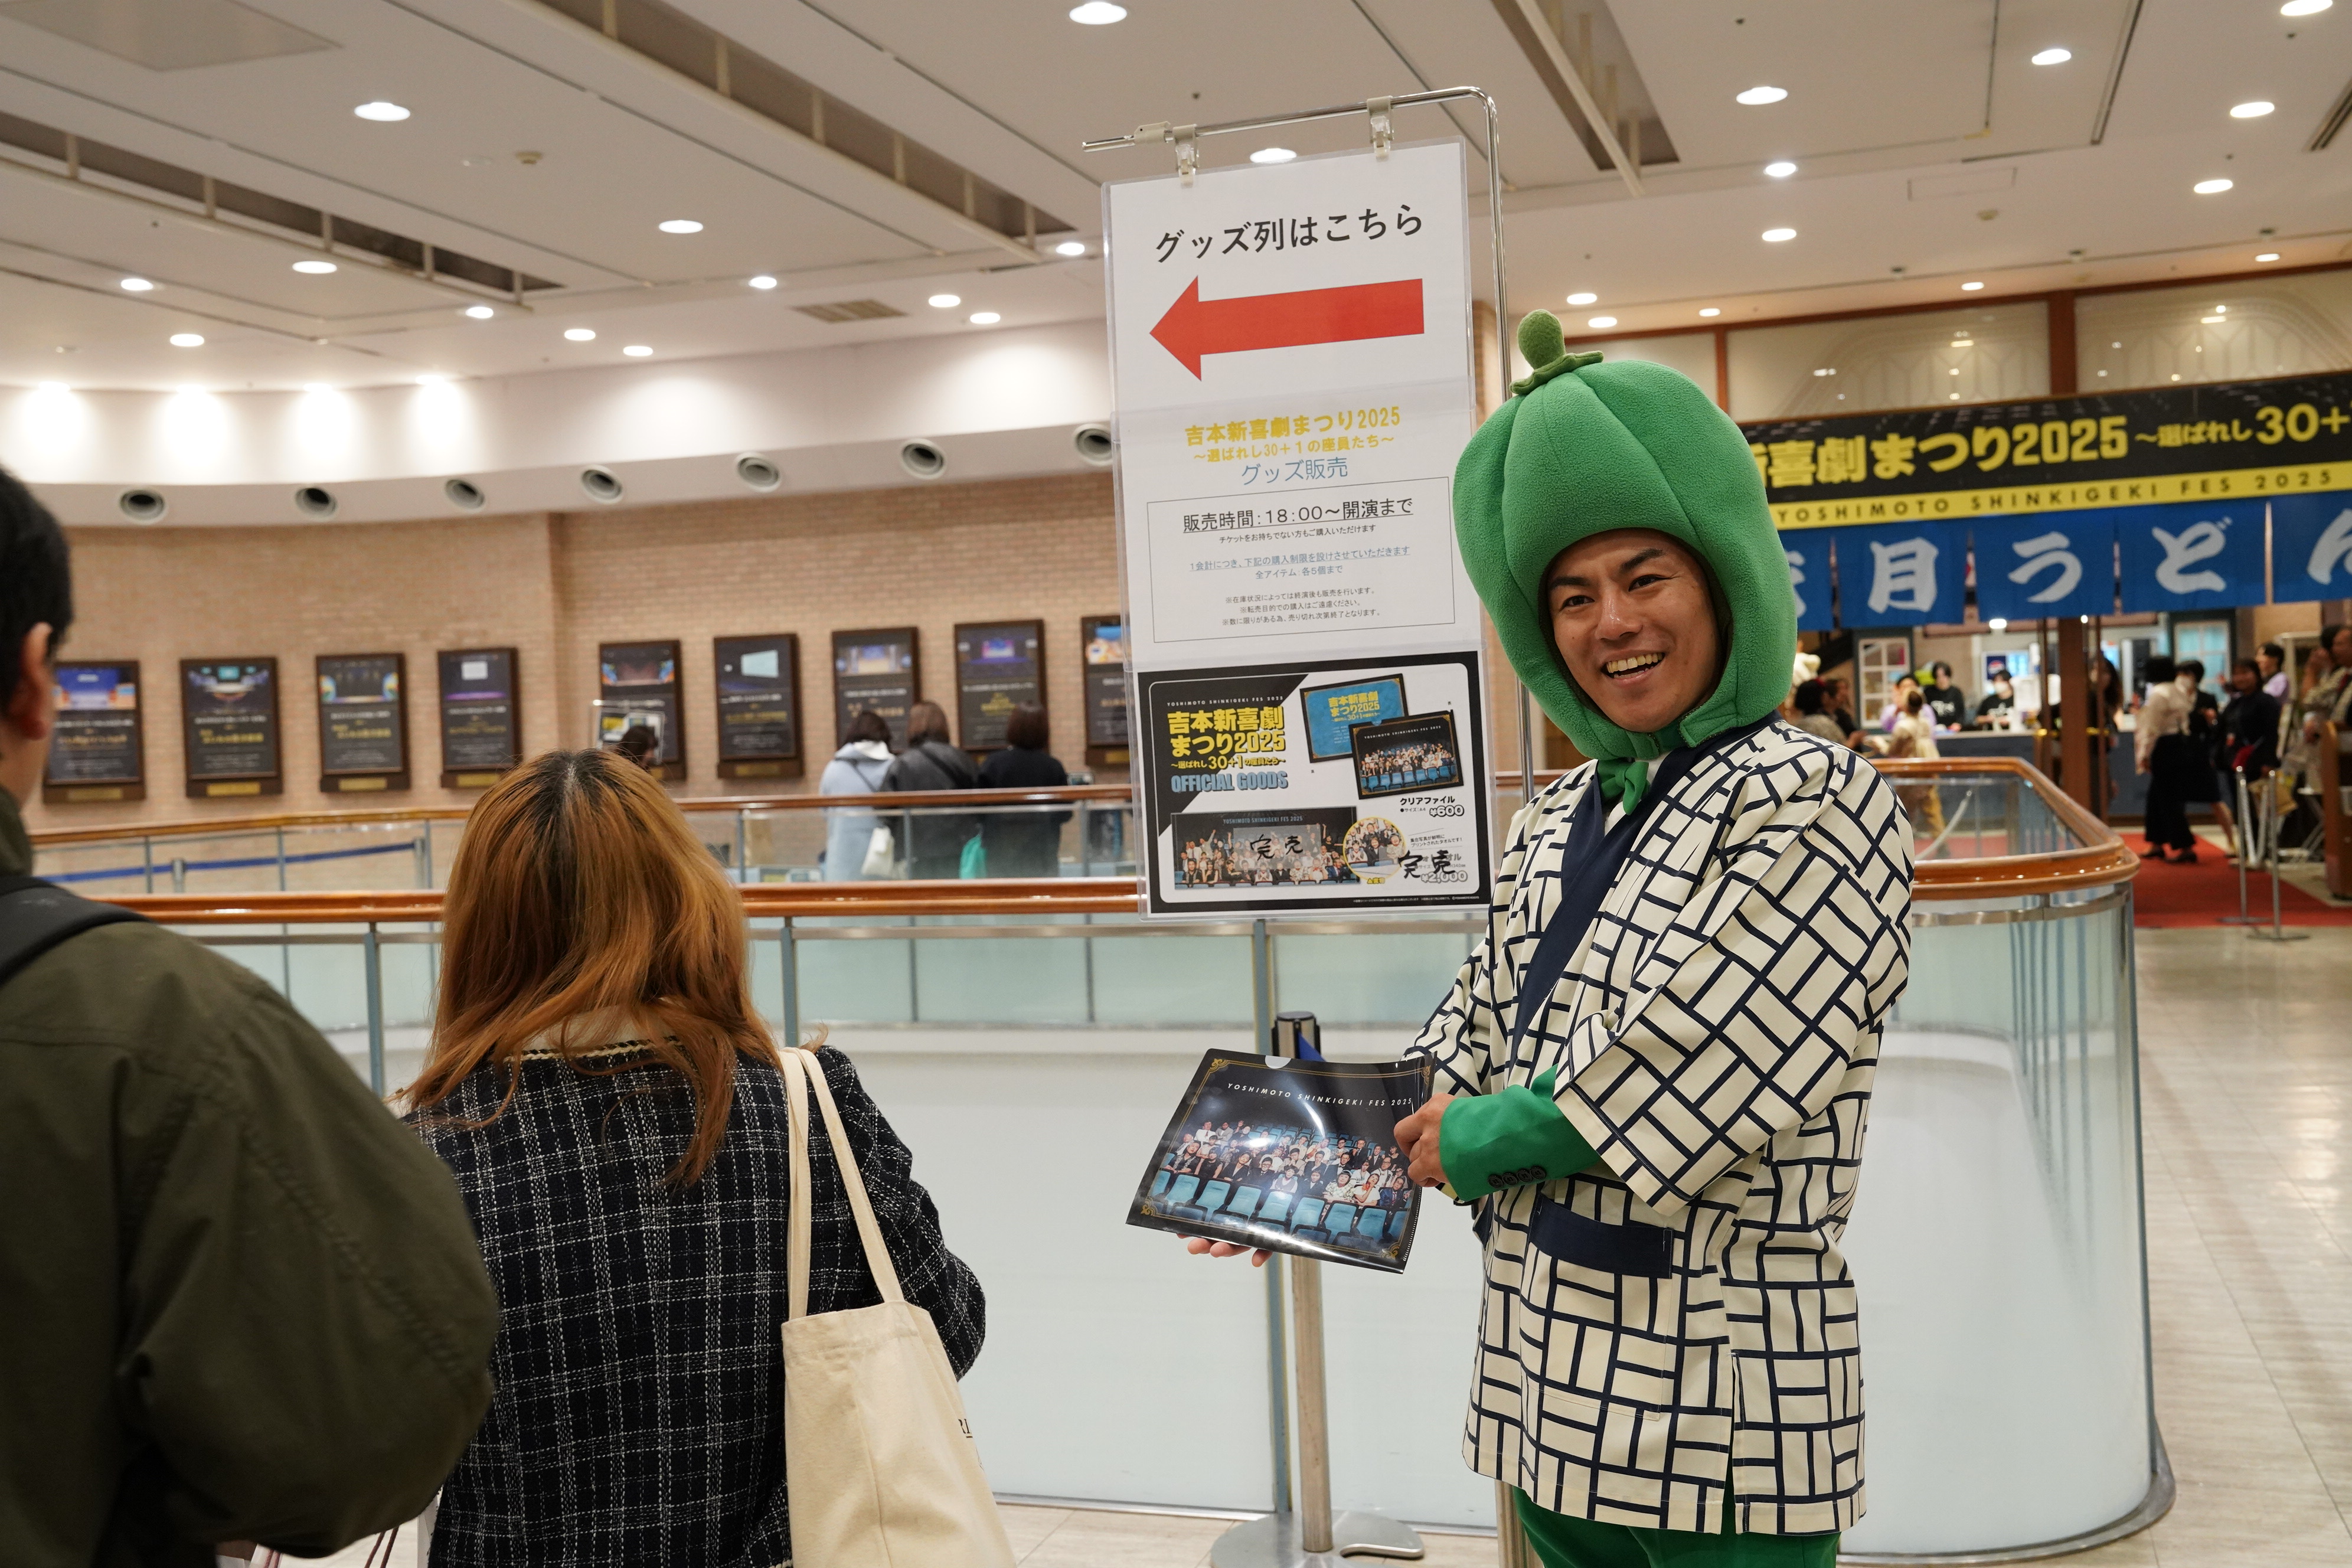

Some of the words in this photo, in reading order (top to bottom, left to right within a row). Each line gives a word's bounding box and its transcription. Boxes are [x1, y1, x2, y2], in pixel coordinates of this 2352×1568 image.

[1155, 204, 1422, 263] グッズ列はこちら
[1185, 406, 1400, 446] 吉本新喜劇まつり2025
[2135, 402, 2352, 447] ～選ばれし30+
[1241, 457, 1348, 485] グッズ販売
[1778, 498, 1949, 524] YOSHIMOTO
[1971, 485, 2157, 510] SHINKIGEKI
[2180, 477, 2232, 495] FES
[2255, 469, 2331, 490] 2025
[1183, 497, 1413, 532] 販売時間:18:00～開演まで
[1219, 525, 1376, 544] チケットをお持ちでない方もご購入いただけます
[1190, 546, 1410, 570] 1会計につき、下記の購入制限を設けさせていただきます
[1255, 565, 1343, 580] 全アイテム:各5個まで
[1226, 587, 1375, 604] ※在庫状況によっては終演後も販売を行います。
[1240, 600, 1361, 614] ※転売目的での購入はご遠慮ください。
[1222, 609, 1380, 626] ※数に限りがある為、売り切れ次第終了となります。
[1167, 705, 1285, 734] 吉本新喜劇
[1330, 701, 1380, 717] まつり2025
[1170, 730, 1286, 757] まつり2025
[1171, 773, 1234, 793] OFFICIAL
[1237, 770, 1289, 790] GOODS
[1400, 796, 1455, 806] クリアファイル
[1429, 805, 1465, 817] ¥600
[1250, 834, 1304, 861] 完売
[1398, 850, 1456, 879] 完売
[1227, 1083, 1291, 1098] YOSHIMOTO
[1297, 1093, 1363, 1106] SHINKIGEKI
[1391, 1097, 1412, 1106] 2025
